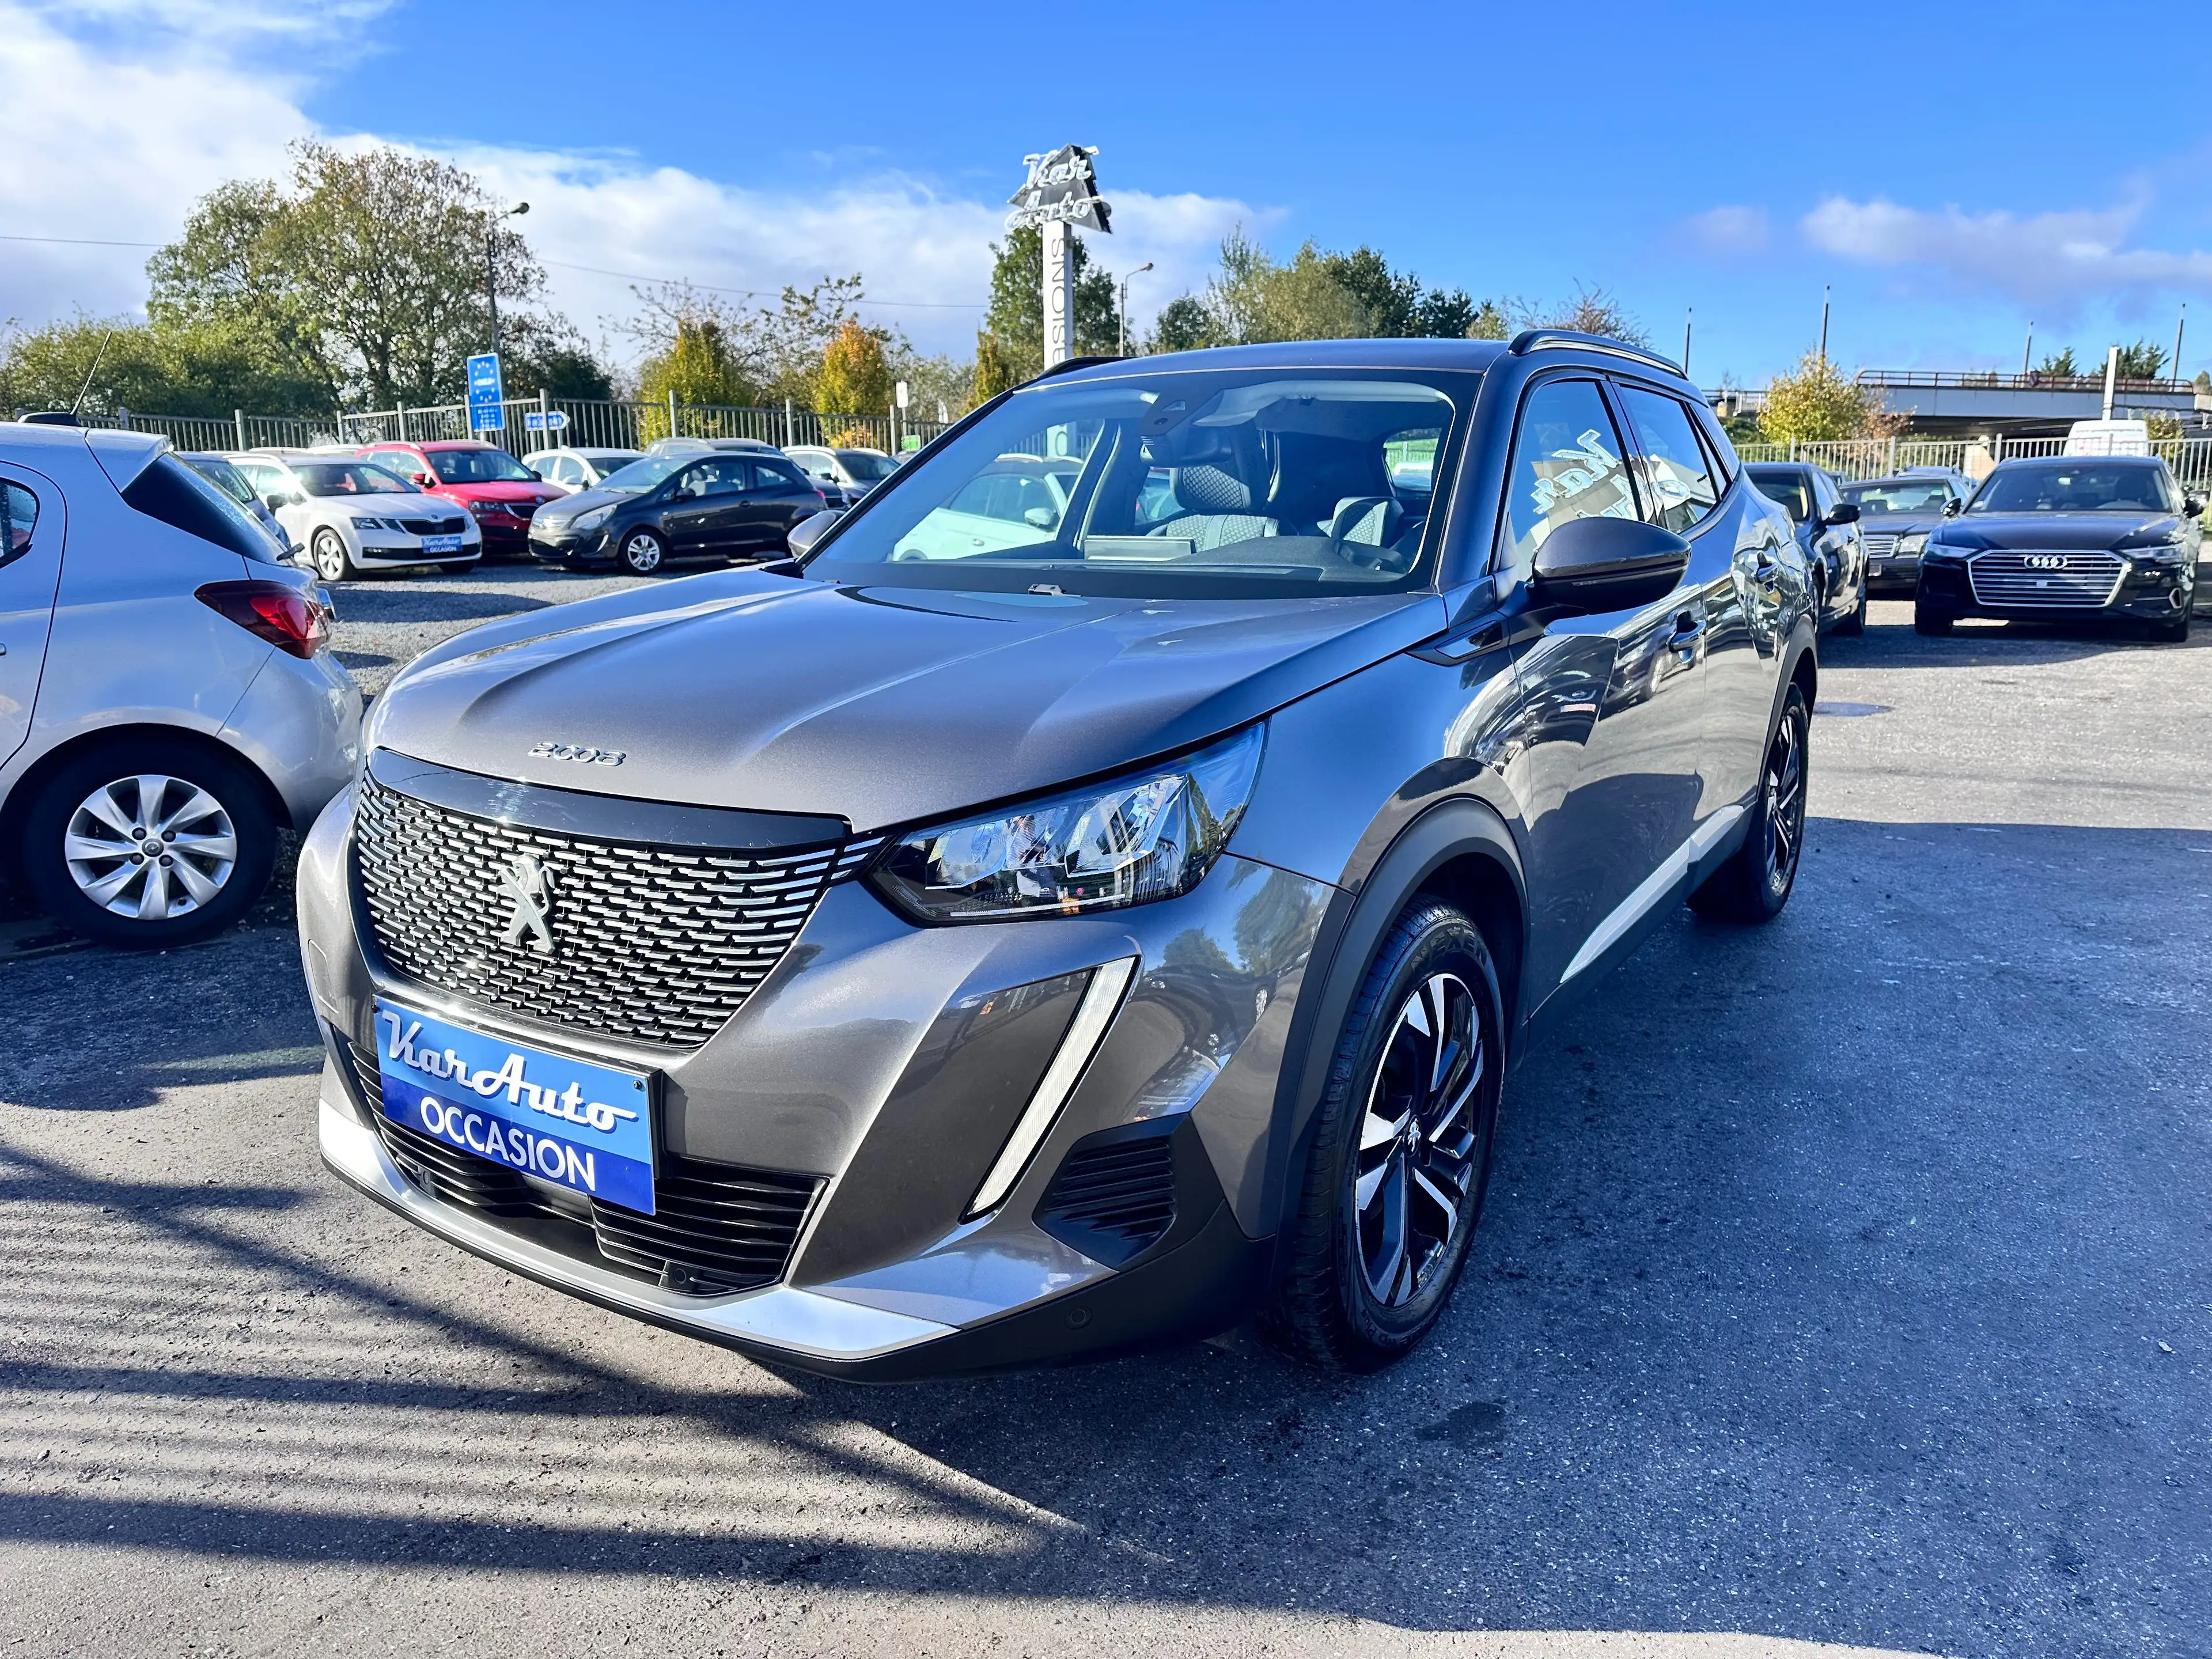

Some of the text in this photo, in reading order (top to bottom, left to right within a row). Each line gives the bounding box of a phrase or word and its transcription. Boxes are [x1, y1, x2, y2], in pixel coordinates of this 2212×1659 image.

[527, 741, 627, 767] 2008
[1411, 927, 1488, 974] NEXEN
[420, 1096, 596, 1192] OCCASION
